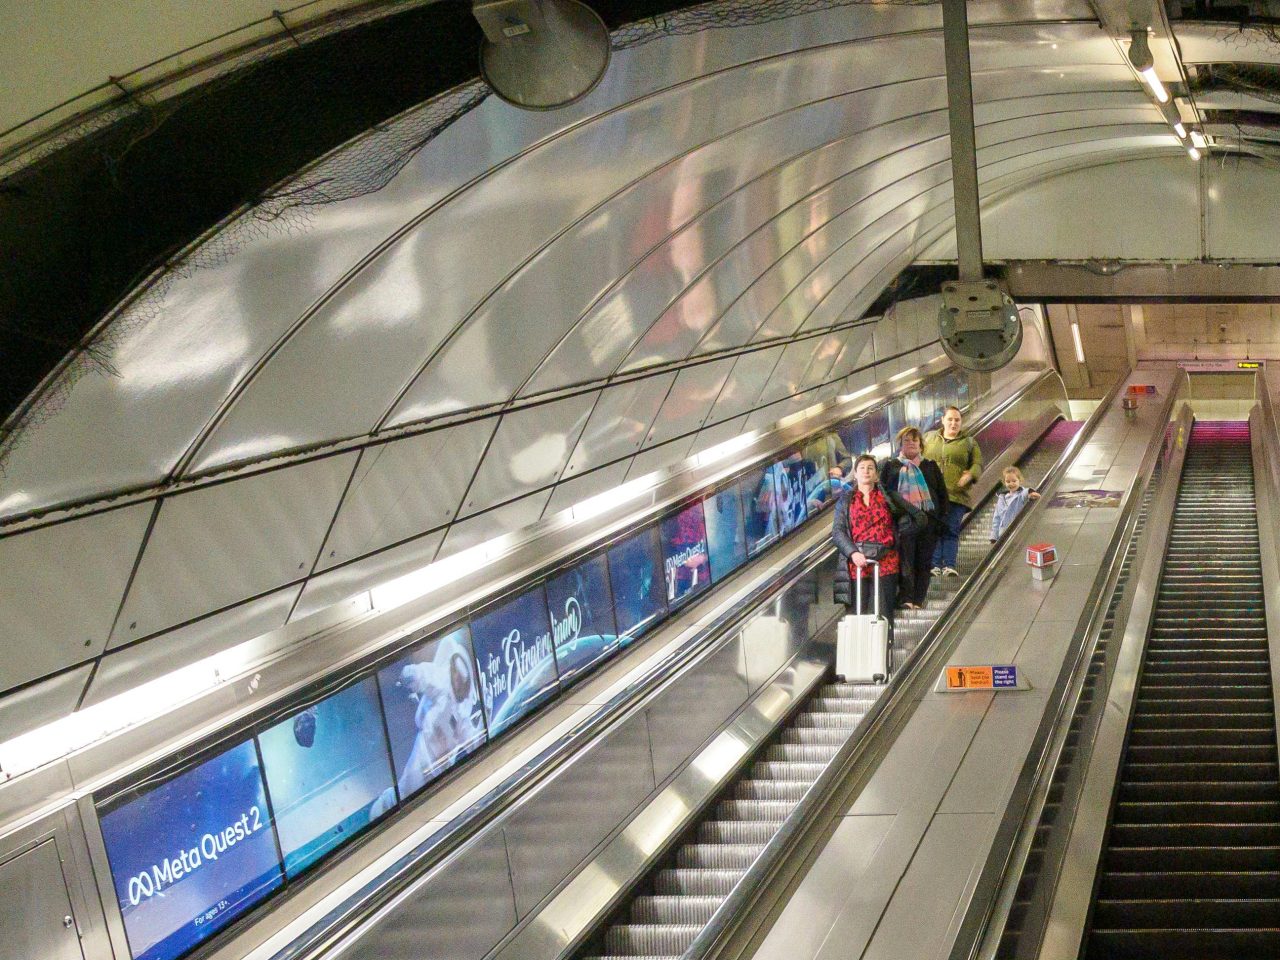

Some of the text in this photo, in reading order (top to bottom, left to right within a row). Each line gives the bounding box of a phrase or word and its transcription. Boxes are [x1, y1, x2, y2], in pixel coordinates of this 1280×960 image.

[501, 596, 582, 698] Extraordinary
[493, 674, 507, 698] the
[152, 805, 263, 891] Meta Quest 2
[194, 915, 205, 927] For
[205, 906, 219, 920] ages
